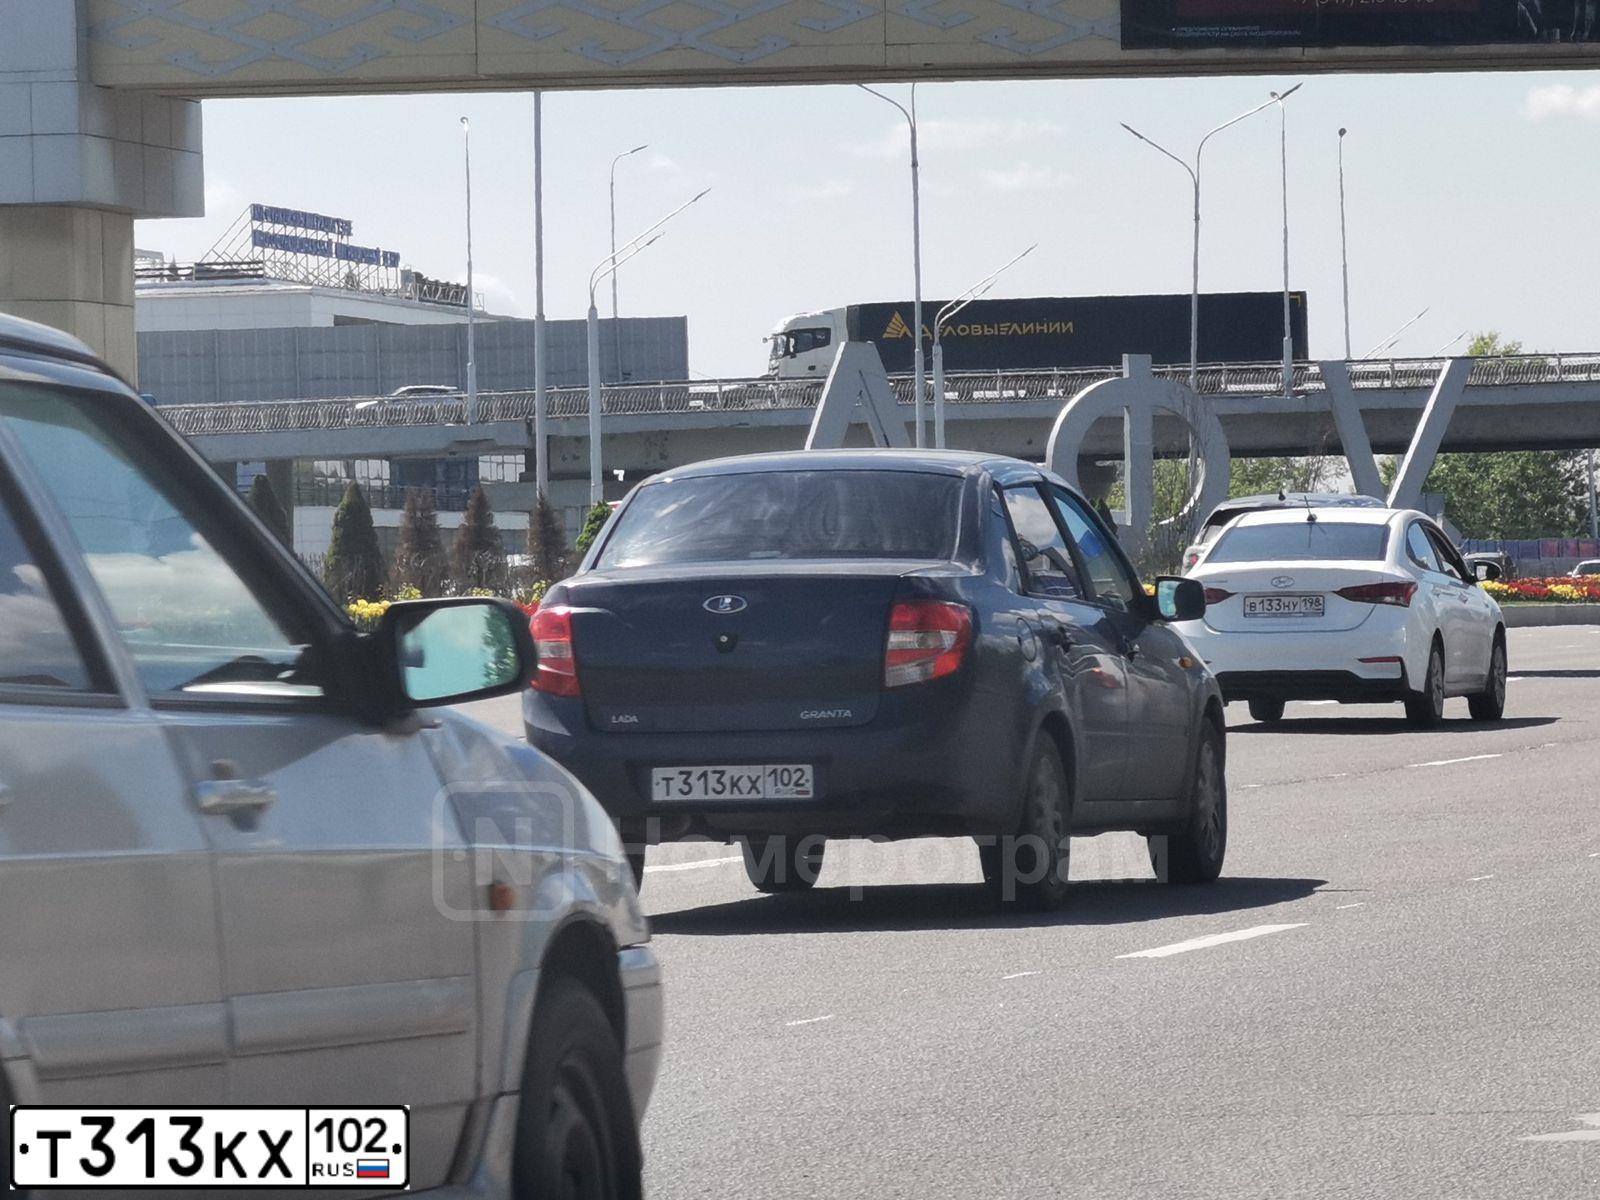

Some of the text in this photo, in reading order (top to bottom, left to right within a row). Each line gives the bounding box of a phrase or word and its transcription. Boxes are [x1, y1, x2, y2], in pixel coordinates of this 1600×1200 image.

[1249, 598, 1298, 612] В133НУ
[611, 715, 639, 724] LADA
[800, 709, 852, 720] GRANTA
[662, 768, 806, 797] Т313КХ 102
